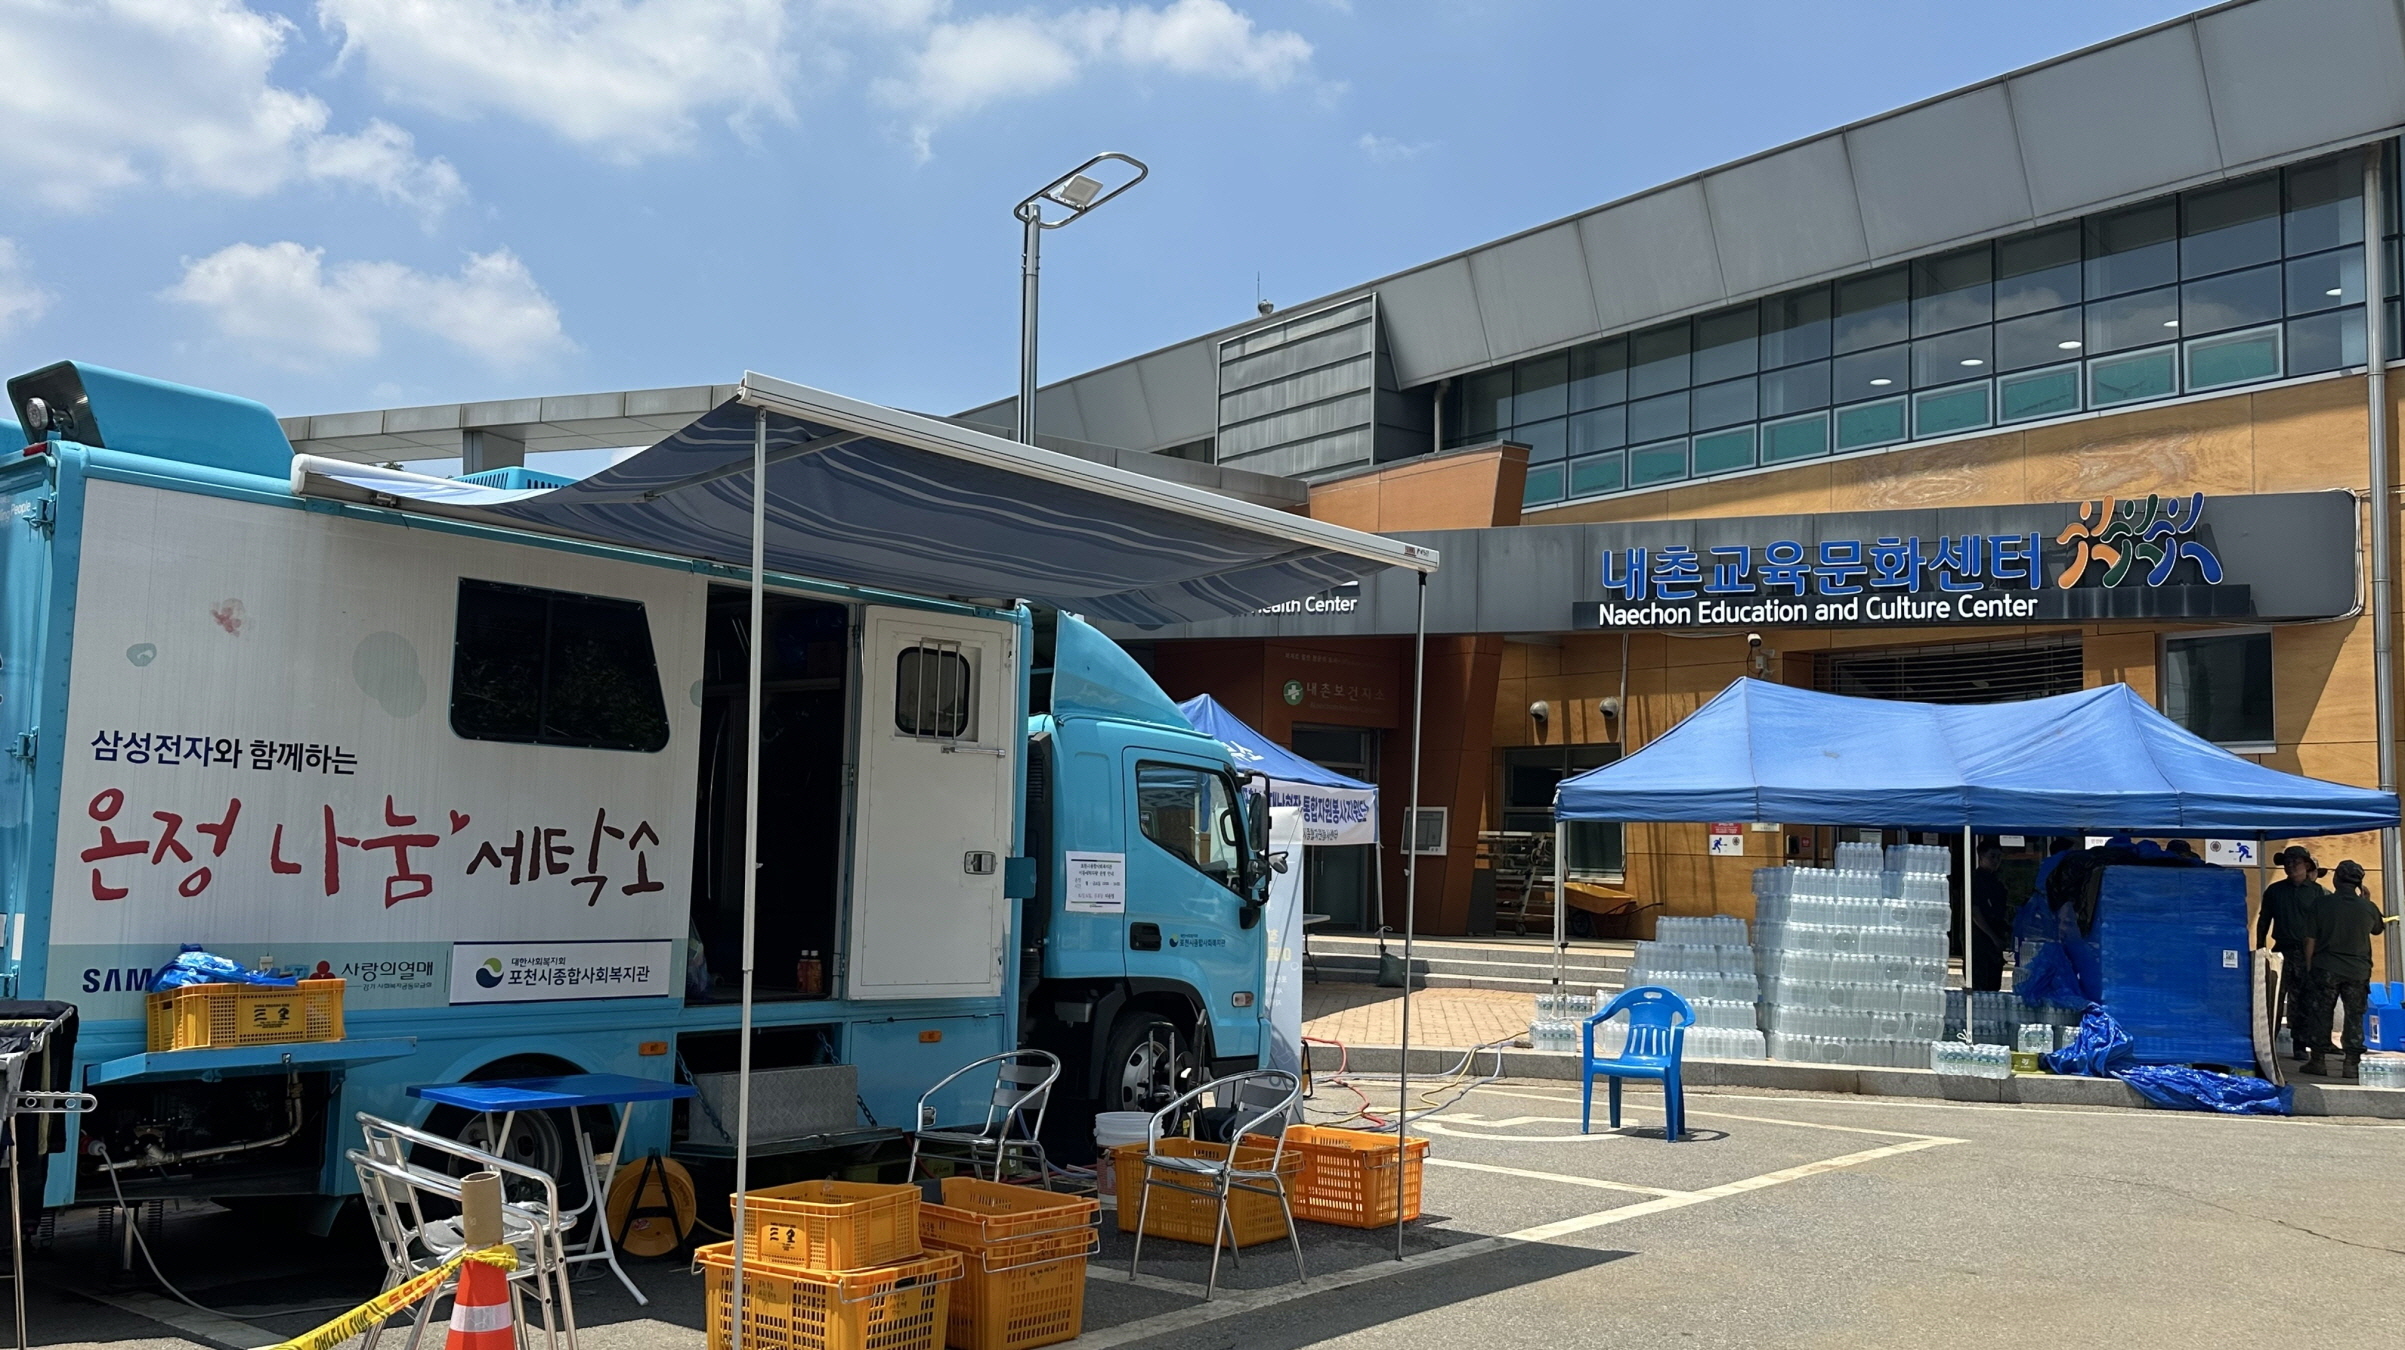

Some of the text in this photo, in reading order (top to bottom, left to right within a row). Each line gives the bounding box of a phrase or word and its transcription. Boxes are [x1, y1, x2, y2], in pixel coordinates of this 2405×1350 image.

[1602, 532, 2041, 601] 내촌교육문화센터
[1257, 596, 1358, 614] ealth Center
[1599, 593, 2038, 626] Naechon Education and Culture Center
[1306, 682, 1385, 701] 내촌보건지소
[91, 730, 358, 775] 삼성전자와 함께하는
[80, 788, 664, 909] 온정 나눔 세탁소
[341, 961, 434, 982] 사랑의열매
[511, 957, 566, 967] 대한사회복지회
[508, 966, 650, 986] 포천시종합사회복지관
[363, 983, 376, 992] 경기
